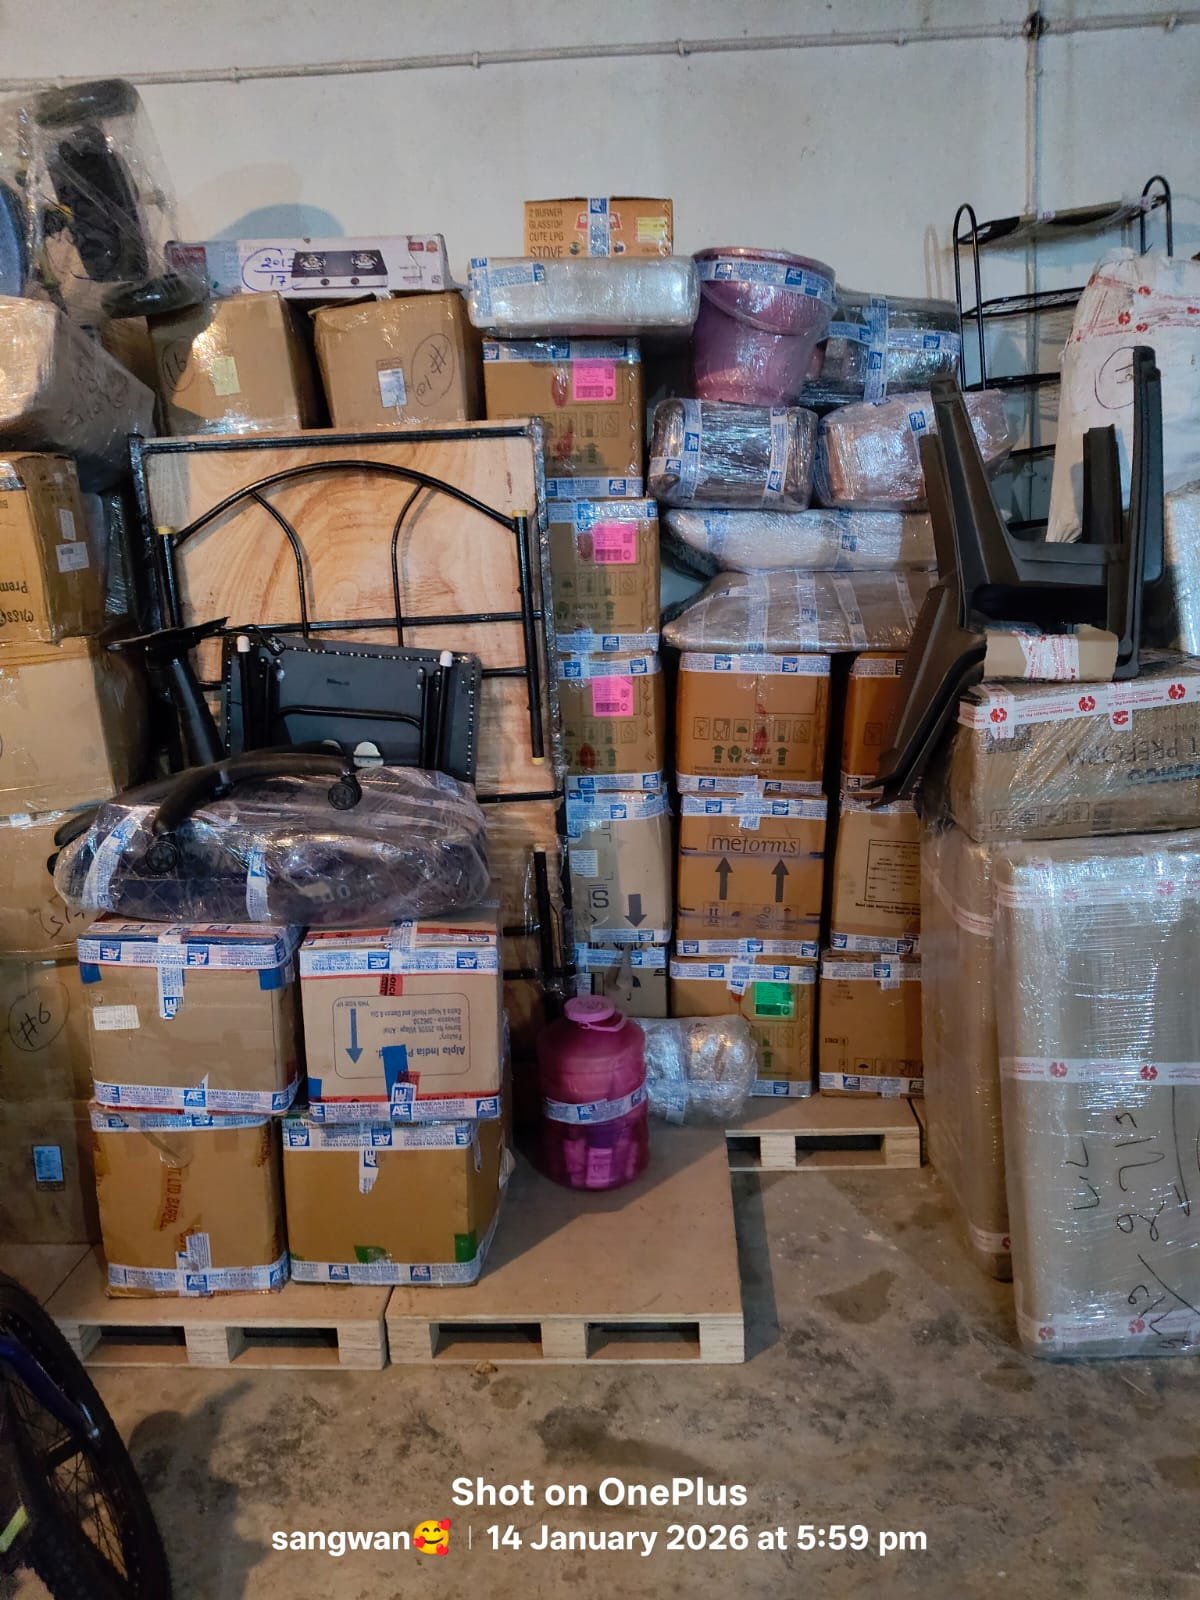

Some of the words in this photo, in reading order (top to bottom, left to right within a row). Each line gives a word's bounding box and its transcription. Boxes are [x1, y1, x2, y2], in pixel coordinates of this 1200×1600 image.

[535, 207, 563, 218] BURNER
[529, 219, 563, 230] GLASSTOP
[529, 232, 548, 242] CUTE
[549, 231, 564, 242] LPG
[529, 246, 564, 258] STOVE
[270, 275, 287, 287] 17
[165, 997, 178, 1017] AE
[16, 1010, 52, 1048] #6
[416, 1047, 439, 1057] India
